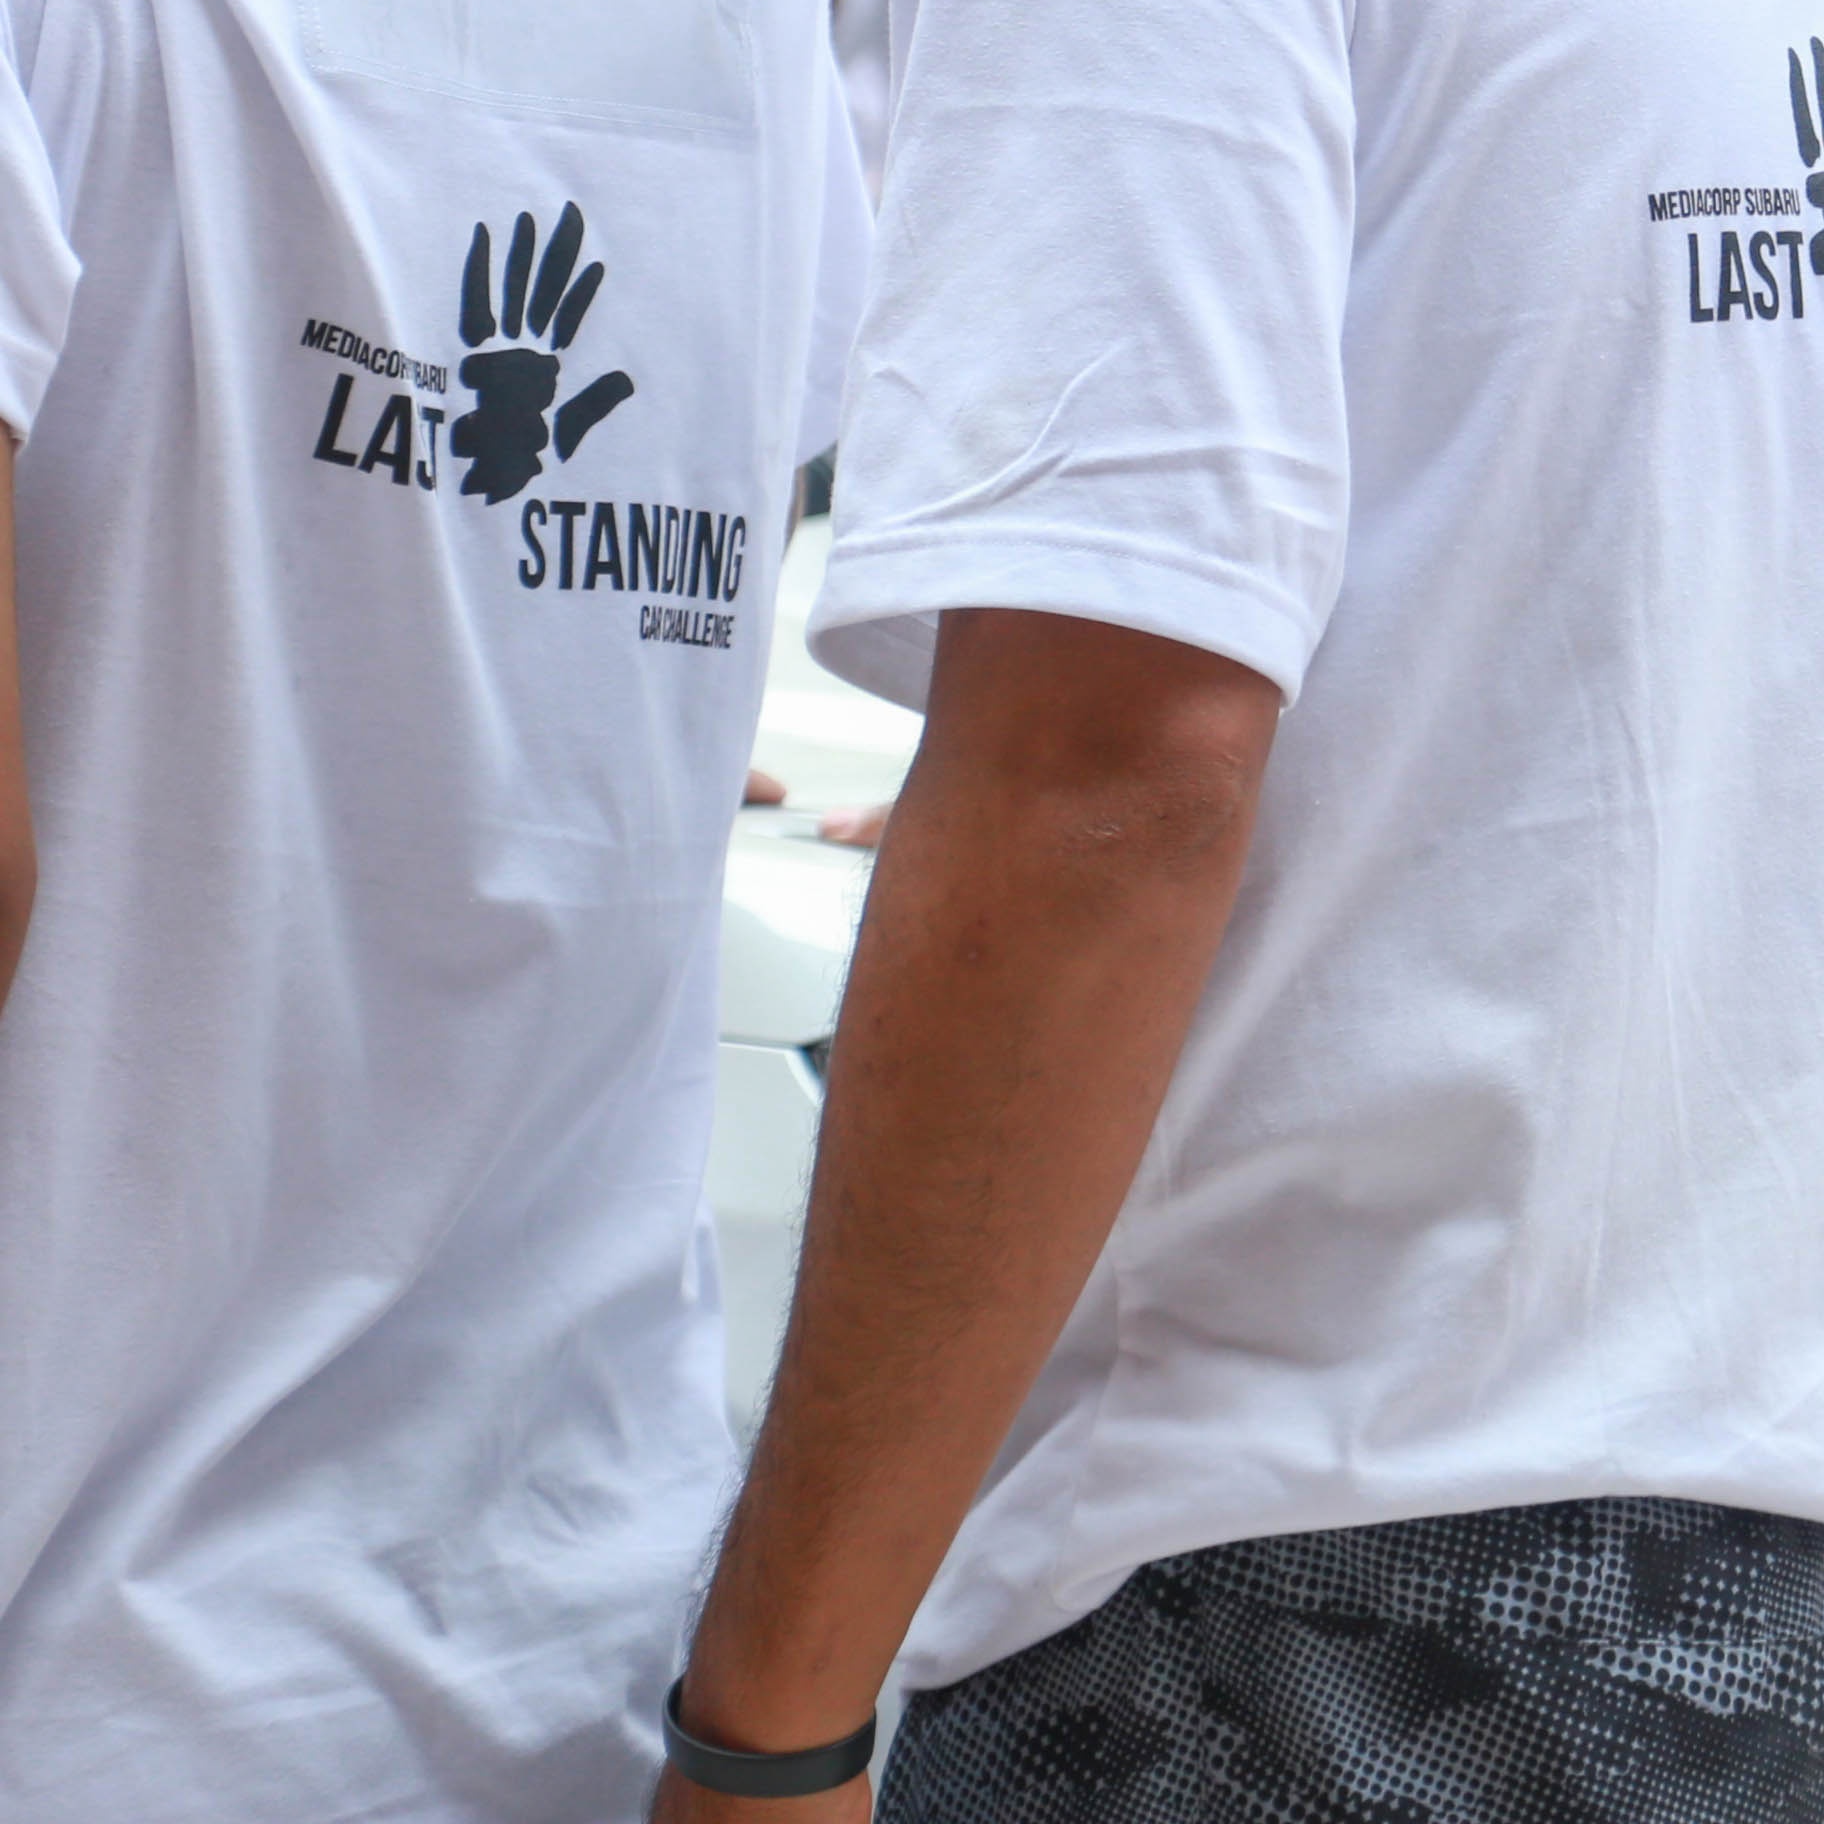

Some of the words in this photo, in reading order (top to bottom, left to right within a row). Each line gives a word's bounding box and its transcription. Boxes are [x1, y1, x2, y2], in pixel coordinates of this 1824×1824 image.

[1649, 188, 1742, 222] MEDIACORP
[1745, 187, 1801, 217] SUBARU
[1688, 230, 1804, 323] LAST
[300, 318, 414, 380] MEDIACO
[518, 499, 746, 603] STANDING
